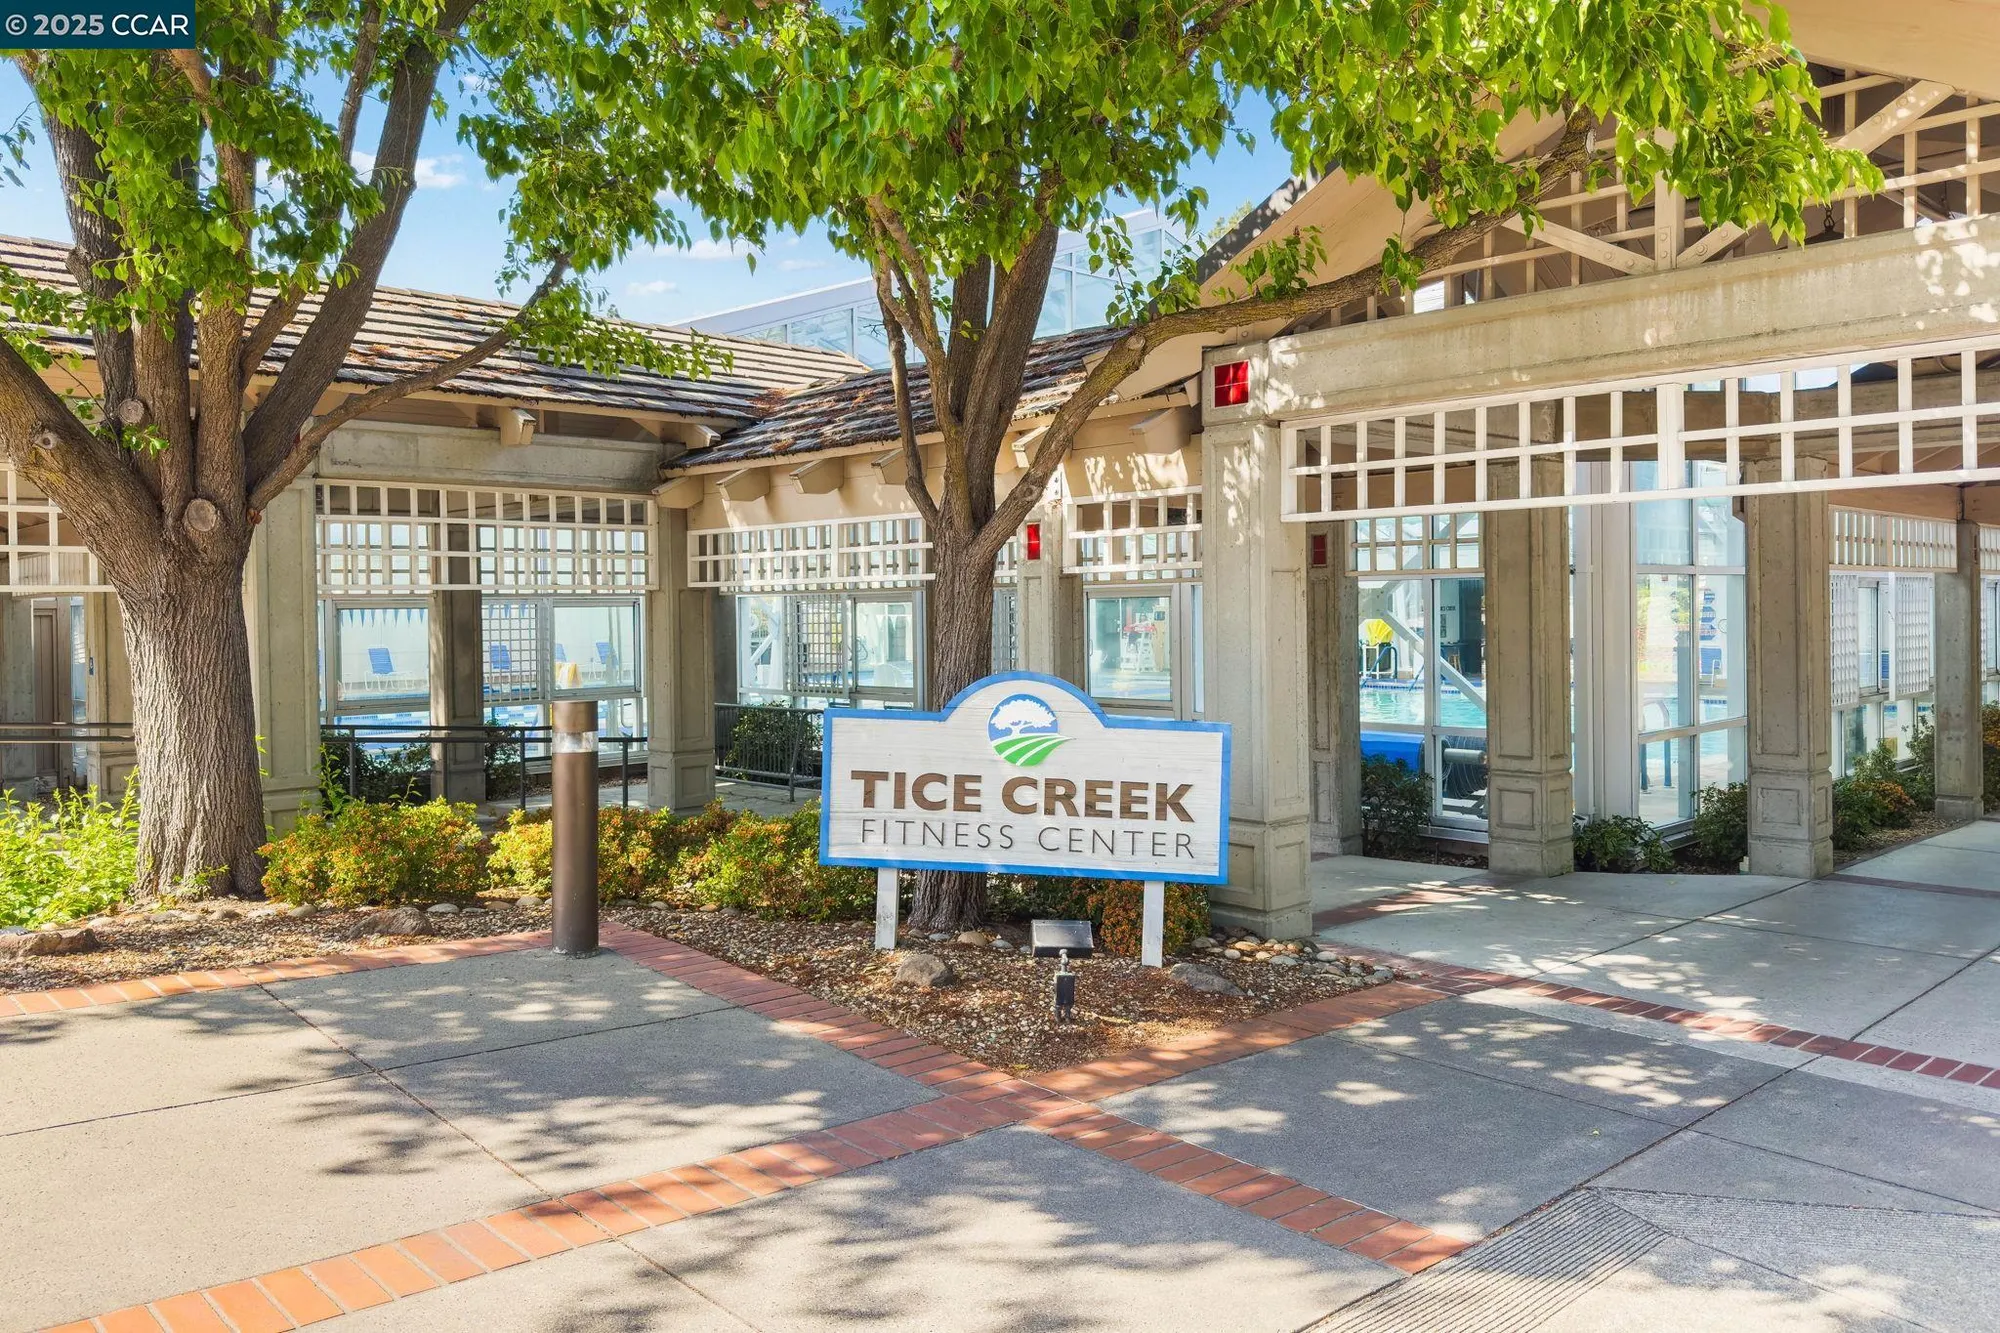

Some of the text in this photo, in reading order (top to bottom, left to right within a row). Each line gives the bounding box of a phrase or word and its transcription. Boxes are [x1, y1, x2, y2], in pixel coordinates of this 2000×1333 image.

[851, 770, 1195, 823] TICE CREEK
[861, 819, 1195, 859] FITNESS CENTER
